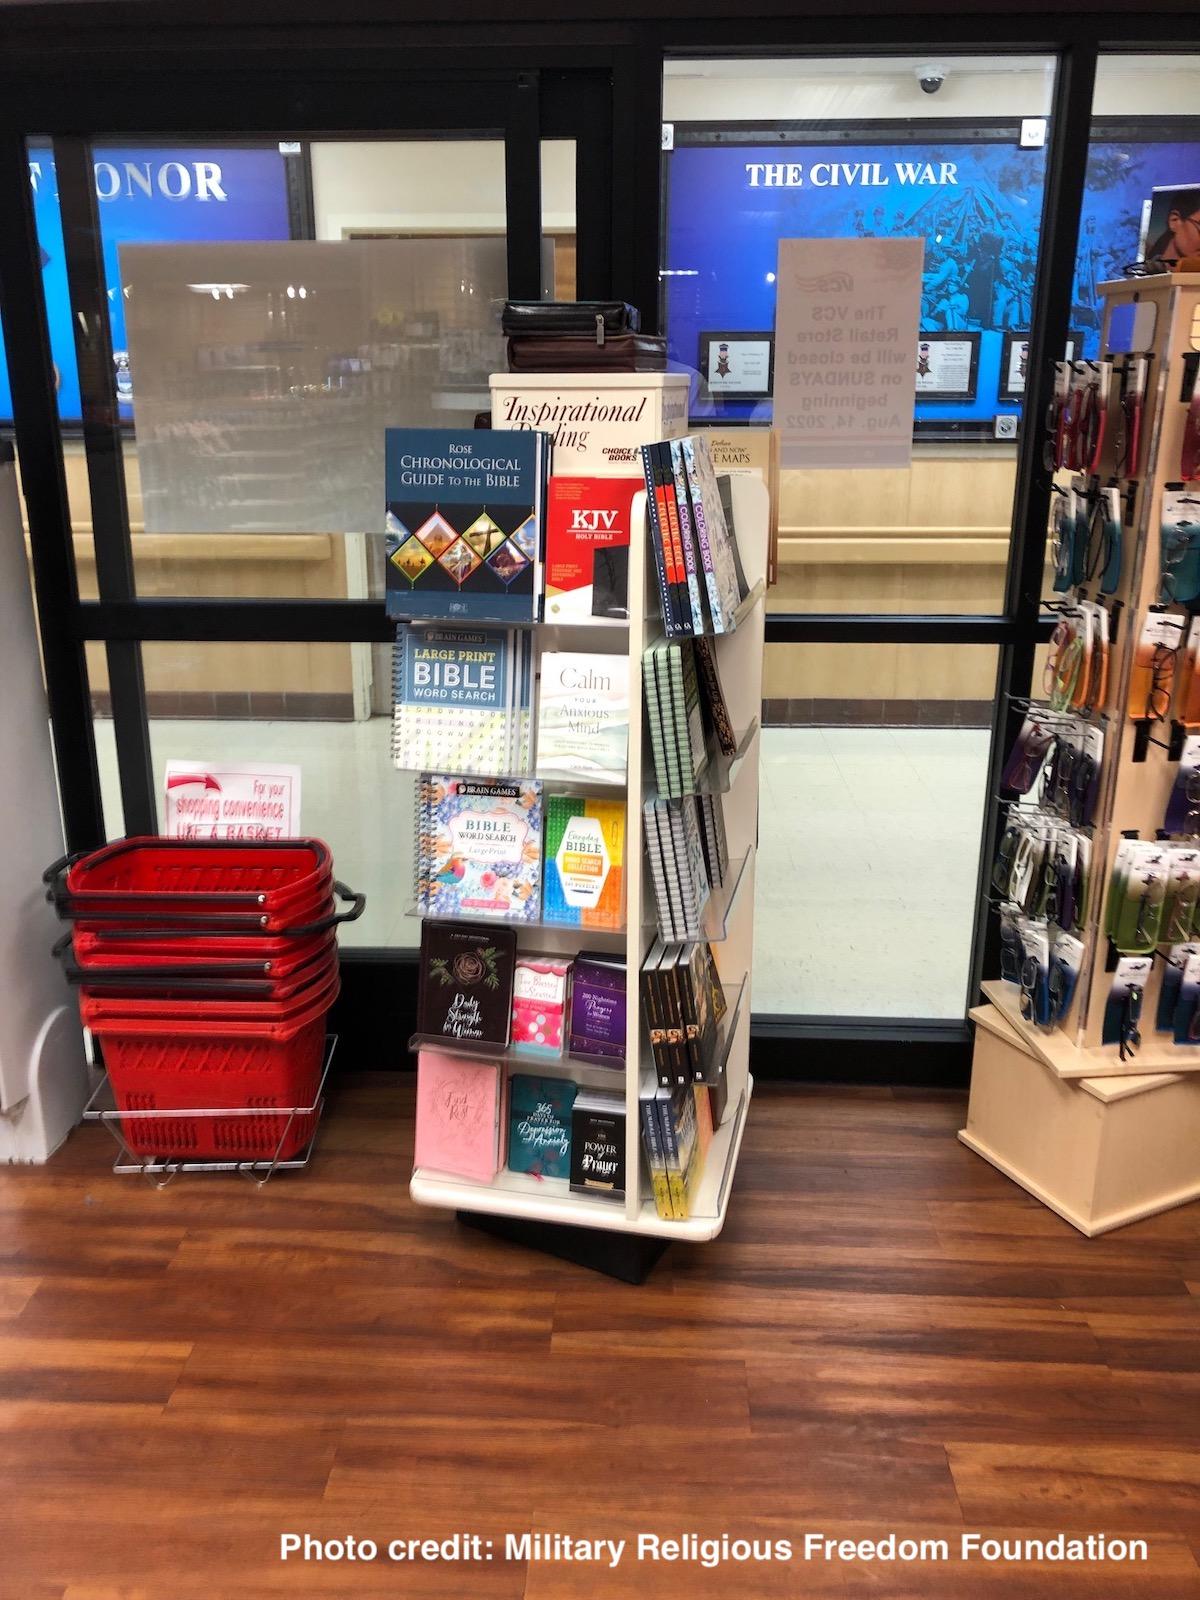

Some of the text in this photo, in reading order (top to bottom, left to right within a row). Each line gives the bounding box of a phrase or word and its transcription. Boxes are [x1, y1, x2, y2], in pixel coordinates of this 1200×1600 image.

[54, 162, 228, 201] ONOR
[746, 162, 958, 187] THE CIVIL WAR
[503, 396, 648, 426] Inspirational
[602, 447, 632, 455] CHOICE
[608, 454, 637, 462] BOOKS
[721, 453, 751, 463] MAPS
[400, 455, 521, 471] CHRONOLOGICAL
[401, 472, 521, 487] GUIDE TO THE BIBLE
[571, 509, 619, 530] KJV
[679, 506, 696, 572] COLORING BOOK
[695, 505, 713, 571] COLORING BOOK
[414, 648, 496, 663] LARGE PRINT
[413, 661, 496, 689] BIBLE
[560, 667, 611, 690] Calm
[413, 687, 496, 701] WORD SEARCH
[560, 704, 610, 719] Anxious
[568, 720, 600, 735] Mind
[253, 779, 285, 798] For your
[466, 786, 517, 796] BRAIN GAMES
[176, 797, 284, 821] shopping convenience
[466, 819, 511, 833] BIBLE
[458, 831, 517, 842] WORD SEARCH
[566, 841, 602, 854] BIBLE
[536, 1102, 552, 1114] 365
[518, 1121, 566, 1136] Depression
[533, 1133, 570, 1156] Anxiety
[584, 1141, 617, 1154] POWER
[582, 1154, 619, 1174] Prayer
